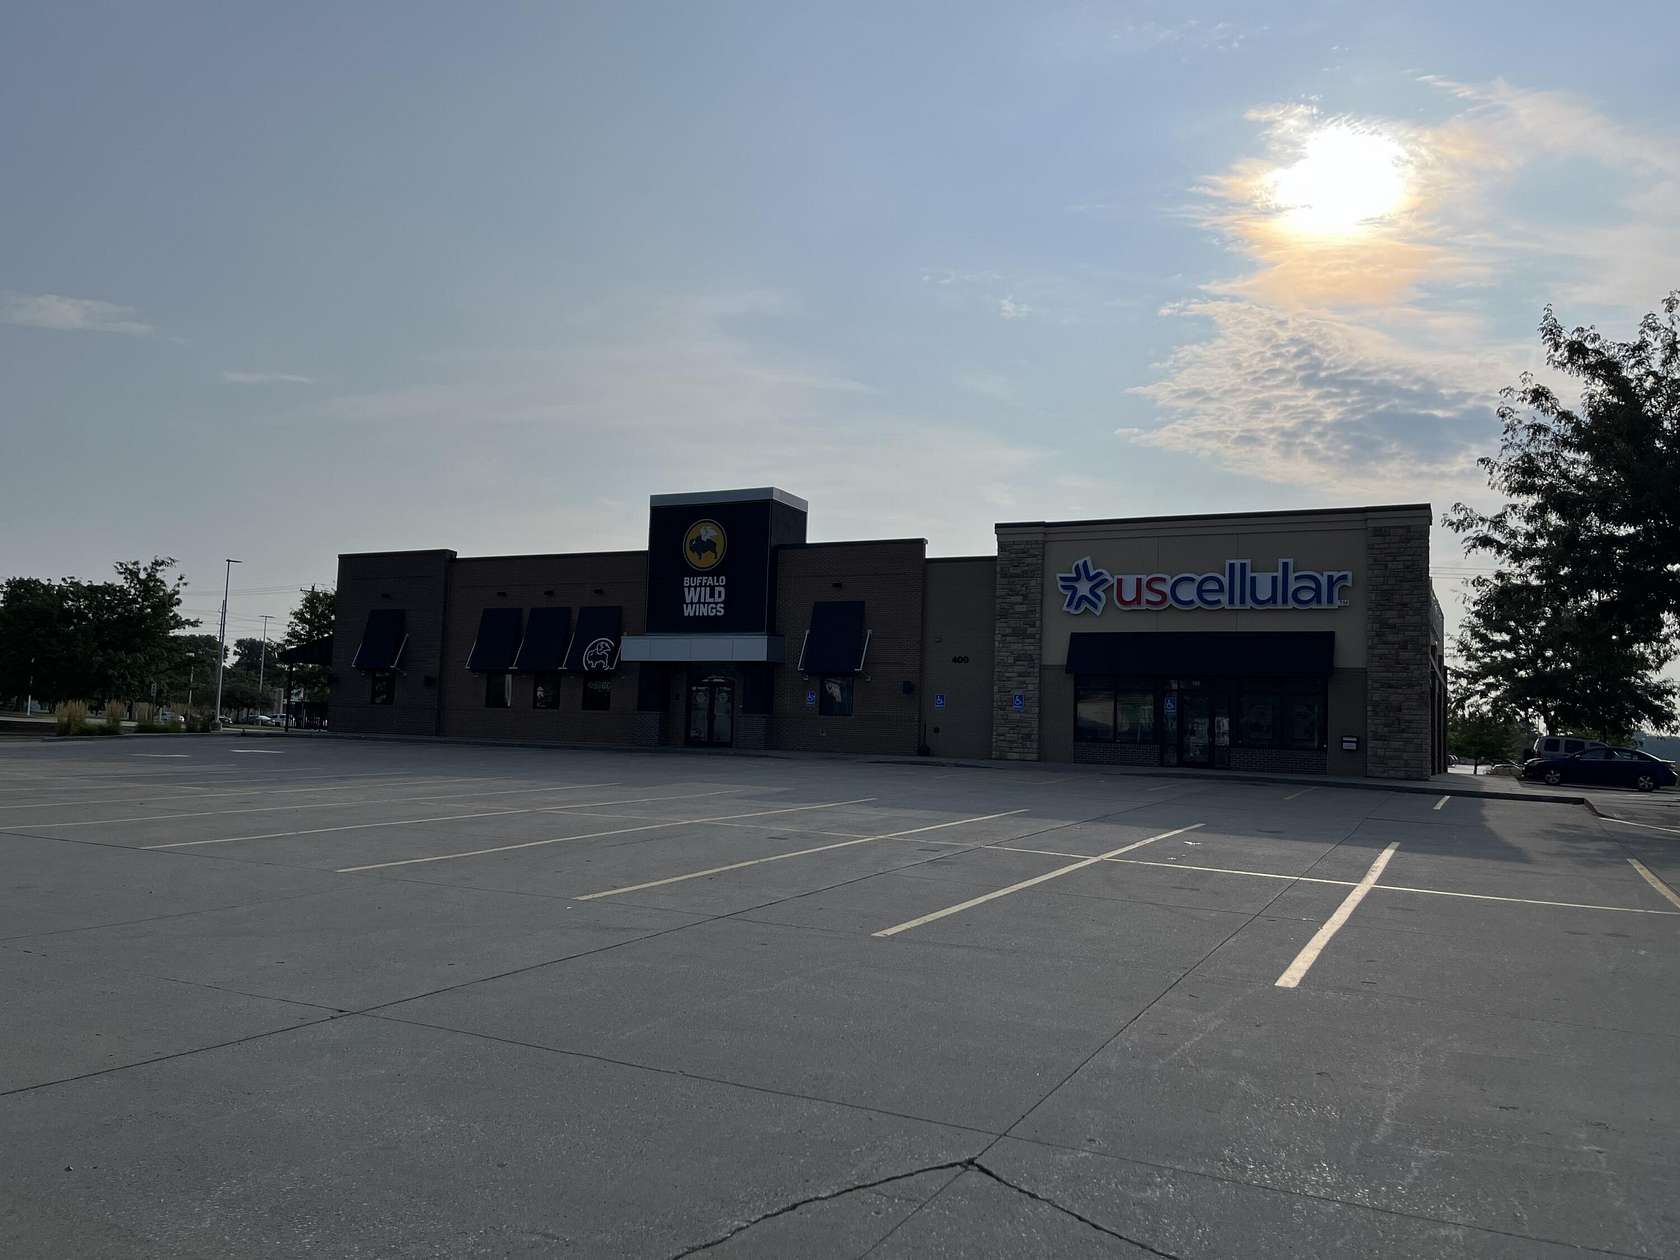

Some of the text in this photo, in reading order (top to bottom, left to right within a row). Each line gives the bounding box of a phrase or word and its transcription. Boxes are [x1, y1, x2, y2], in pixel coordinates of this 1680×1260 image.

[683, 576, 726, 586] BUFFALO
[1115, 560, 1350, 607] uscellular
[684, 587, 726, 603] WILD
[683, 603, 725, 616] WINGS
